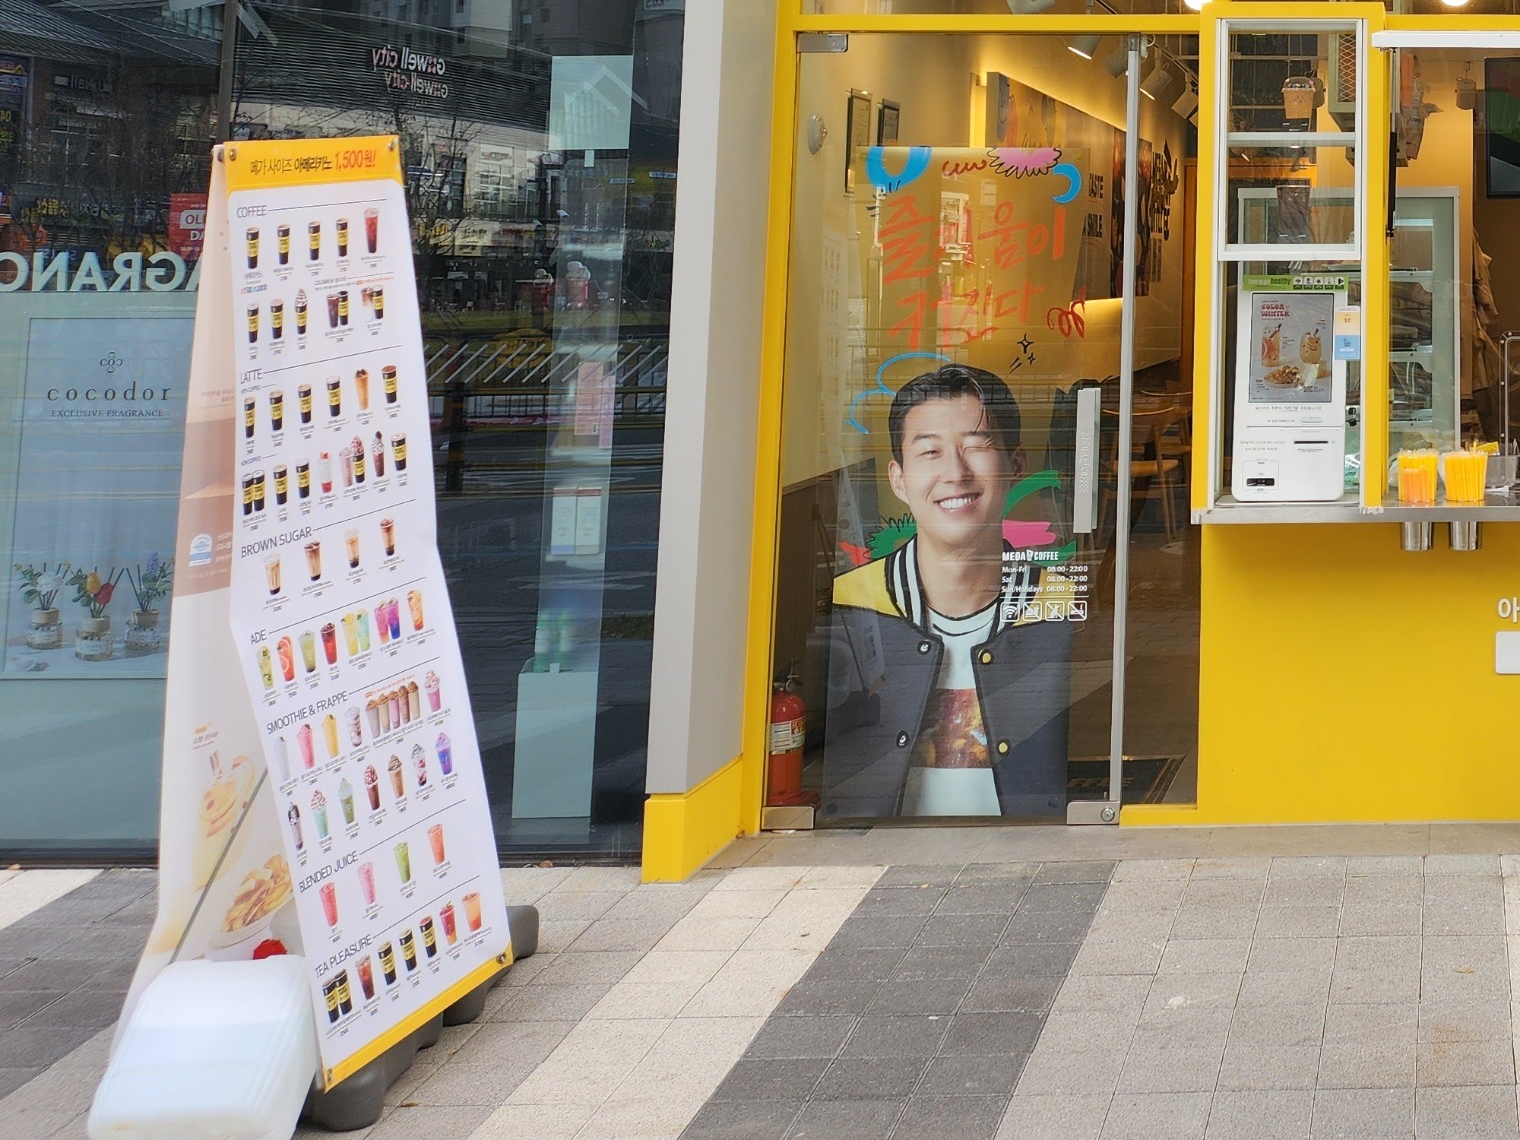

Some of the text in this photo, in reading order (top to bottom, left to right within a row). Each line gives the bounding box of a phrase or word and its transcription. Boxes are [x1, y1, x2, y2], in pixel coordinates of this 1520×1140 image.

[294, 156, 333, 171] 아메리카노
[236, 204, 267, 219] COFFEE
[240, 368, 263, 385] LATTE
[46, 381, 172, 402] cocodor
[51, 409, 165, 418] EXCLUSIVE FRAGRANCE
[241, 534, 278, 558] BROWN
[279, 526, 312, 546] SUGAR
[1002, 551, 1059, 562] MEGA COFFEE
[250, 629, 268, 645] ADE
[266, 691, 349, 734] SMOOTHIE & FRAPPE
[299, 851, 359, 893] BLENDED JUICE
[315, 935, 373, 978] TEA PLEASURE
